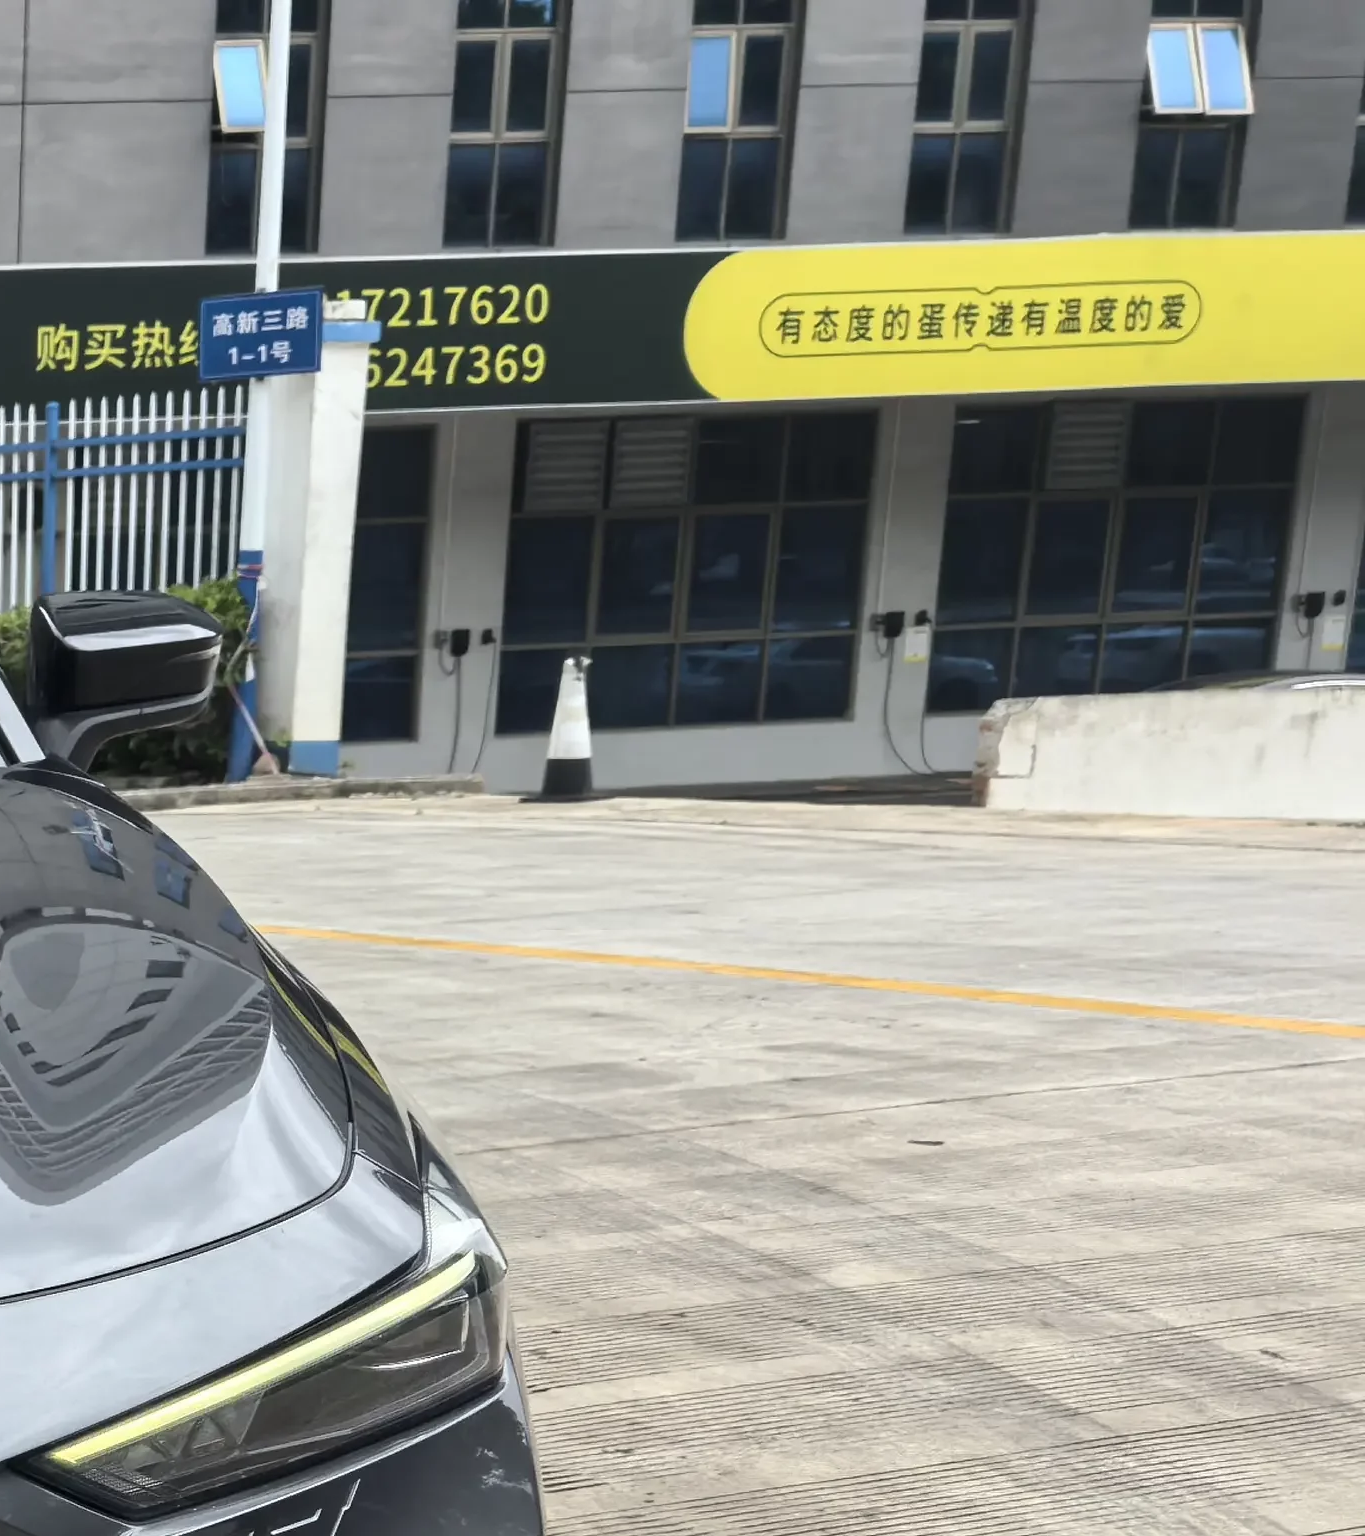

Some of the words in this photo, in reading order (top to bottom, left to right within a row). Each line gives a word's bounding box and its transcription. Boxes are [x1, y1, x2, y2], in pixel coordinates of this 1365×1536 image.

[212, 306, 309, 337] 高新三路
[335, 283, 550, 327] 7217620
[775, 293, 1186, 345] 有态度的蛋传递有温度的爱
